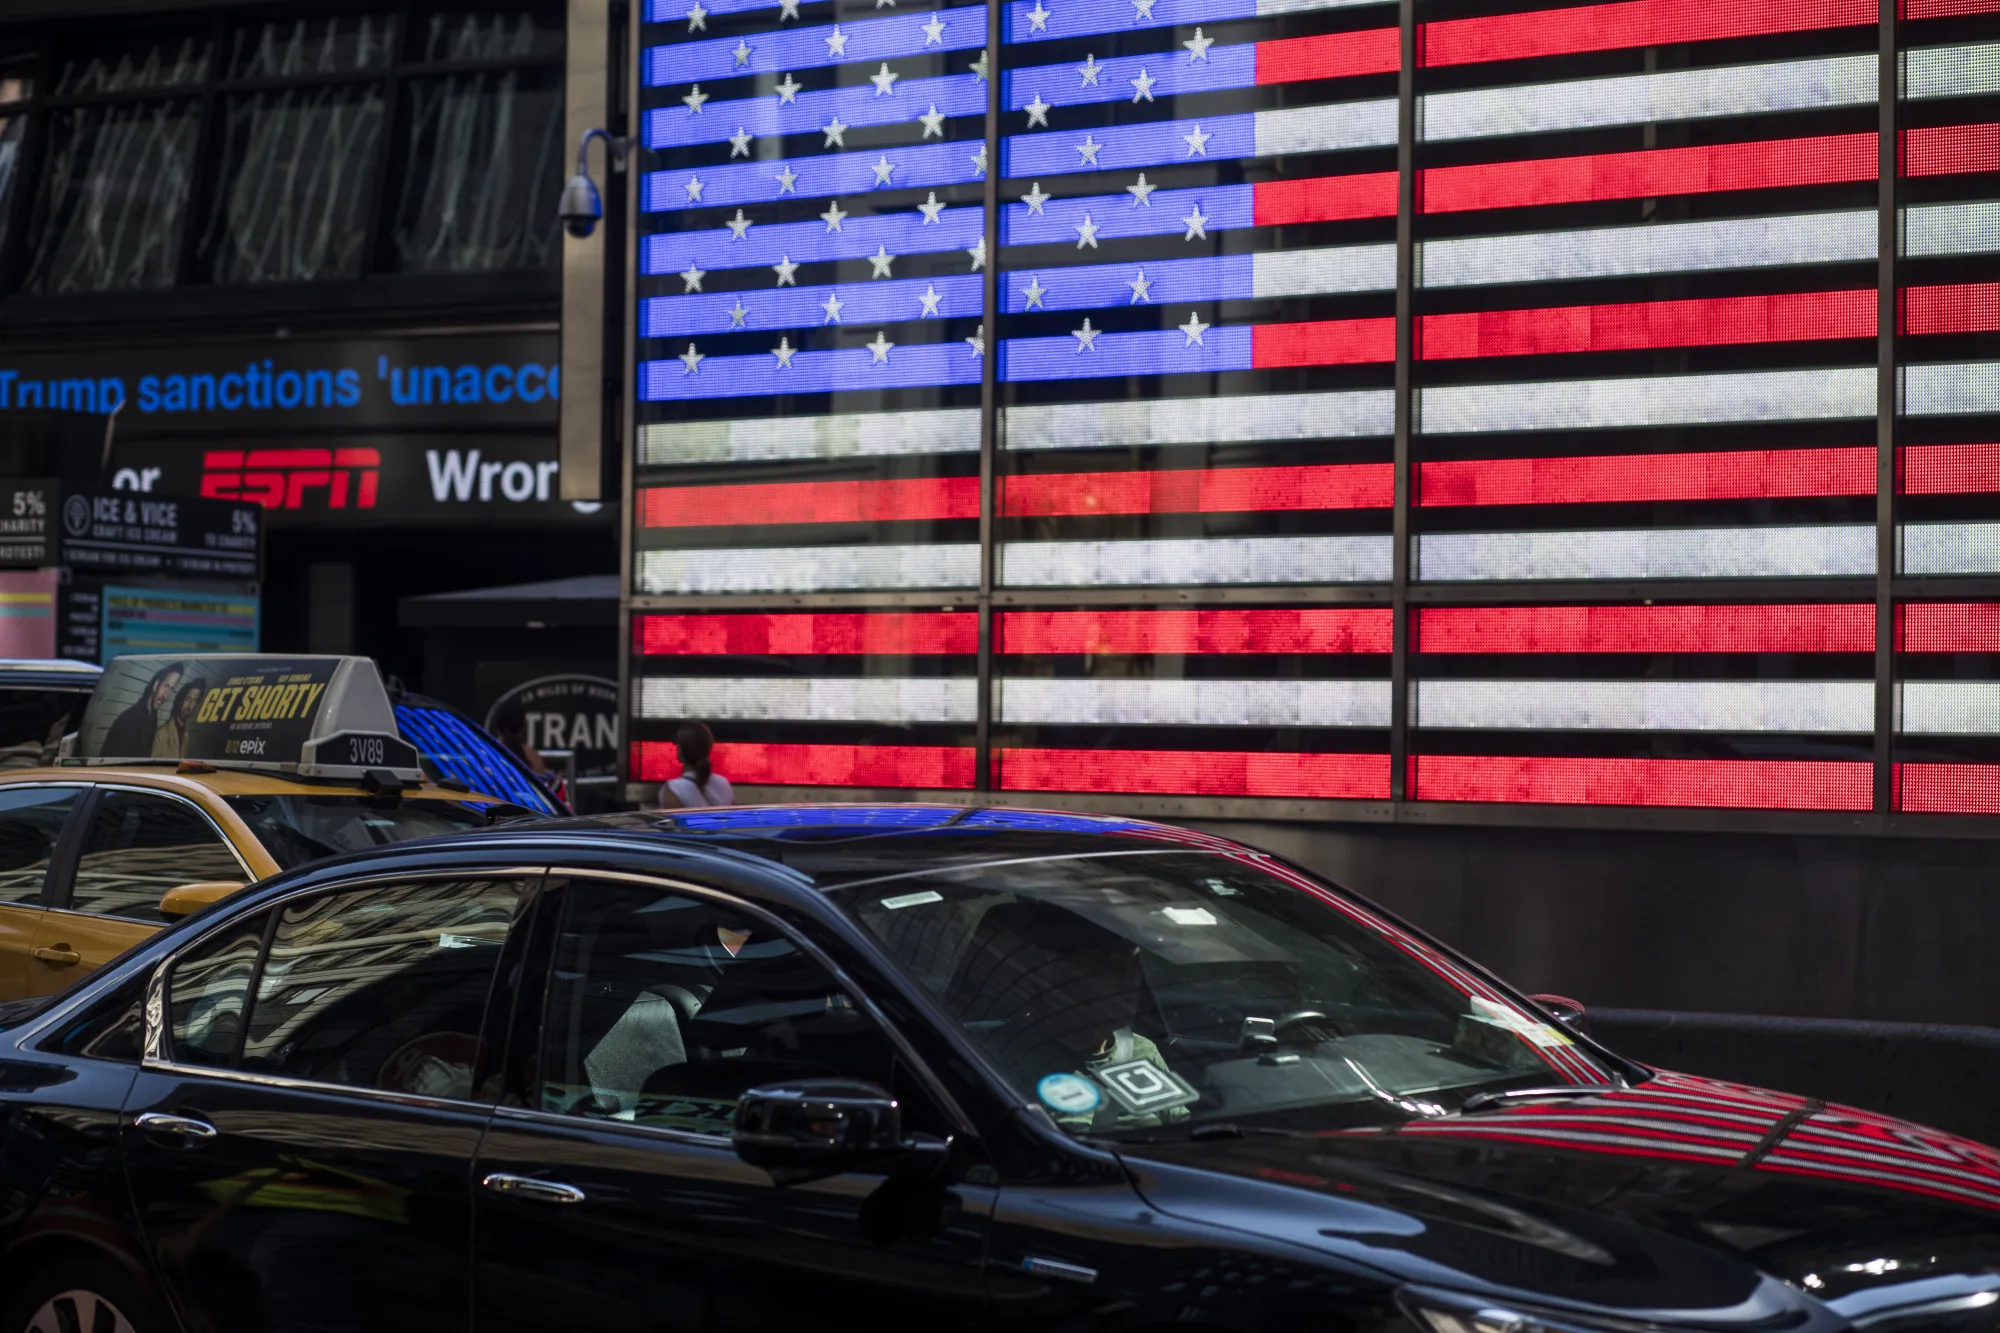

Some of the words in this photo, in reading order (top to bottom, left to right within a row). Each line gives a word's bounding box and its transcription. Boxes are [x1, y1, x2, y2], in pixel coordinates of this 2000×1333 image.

[137, 358, 361, 413] sanctions
[200, 447, 381, 509] ESPN
[426, 449, 603, 514] Wron
[13, 490, 46, 516] 5%
[93, 496, 121, 523] ICE
[140, 501, 179, 528] VICE
[196, 686, 243, 723] GET
[234, 683, 325, 720] SHORTY
[239, 737, 266, 755] epix
[525, 713, 619, 749] TRAN
[350, 737, 384, 764] 3V89
